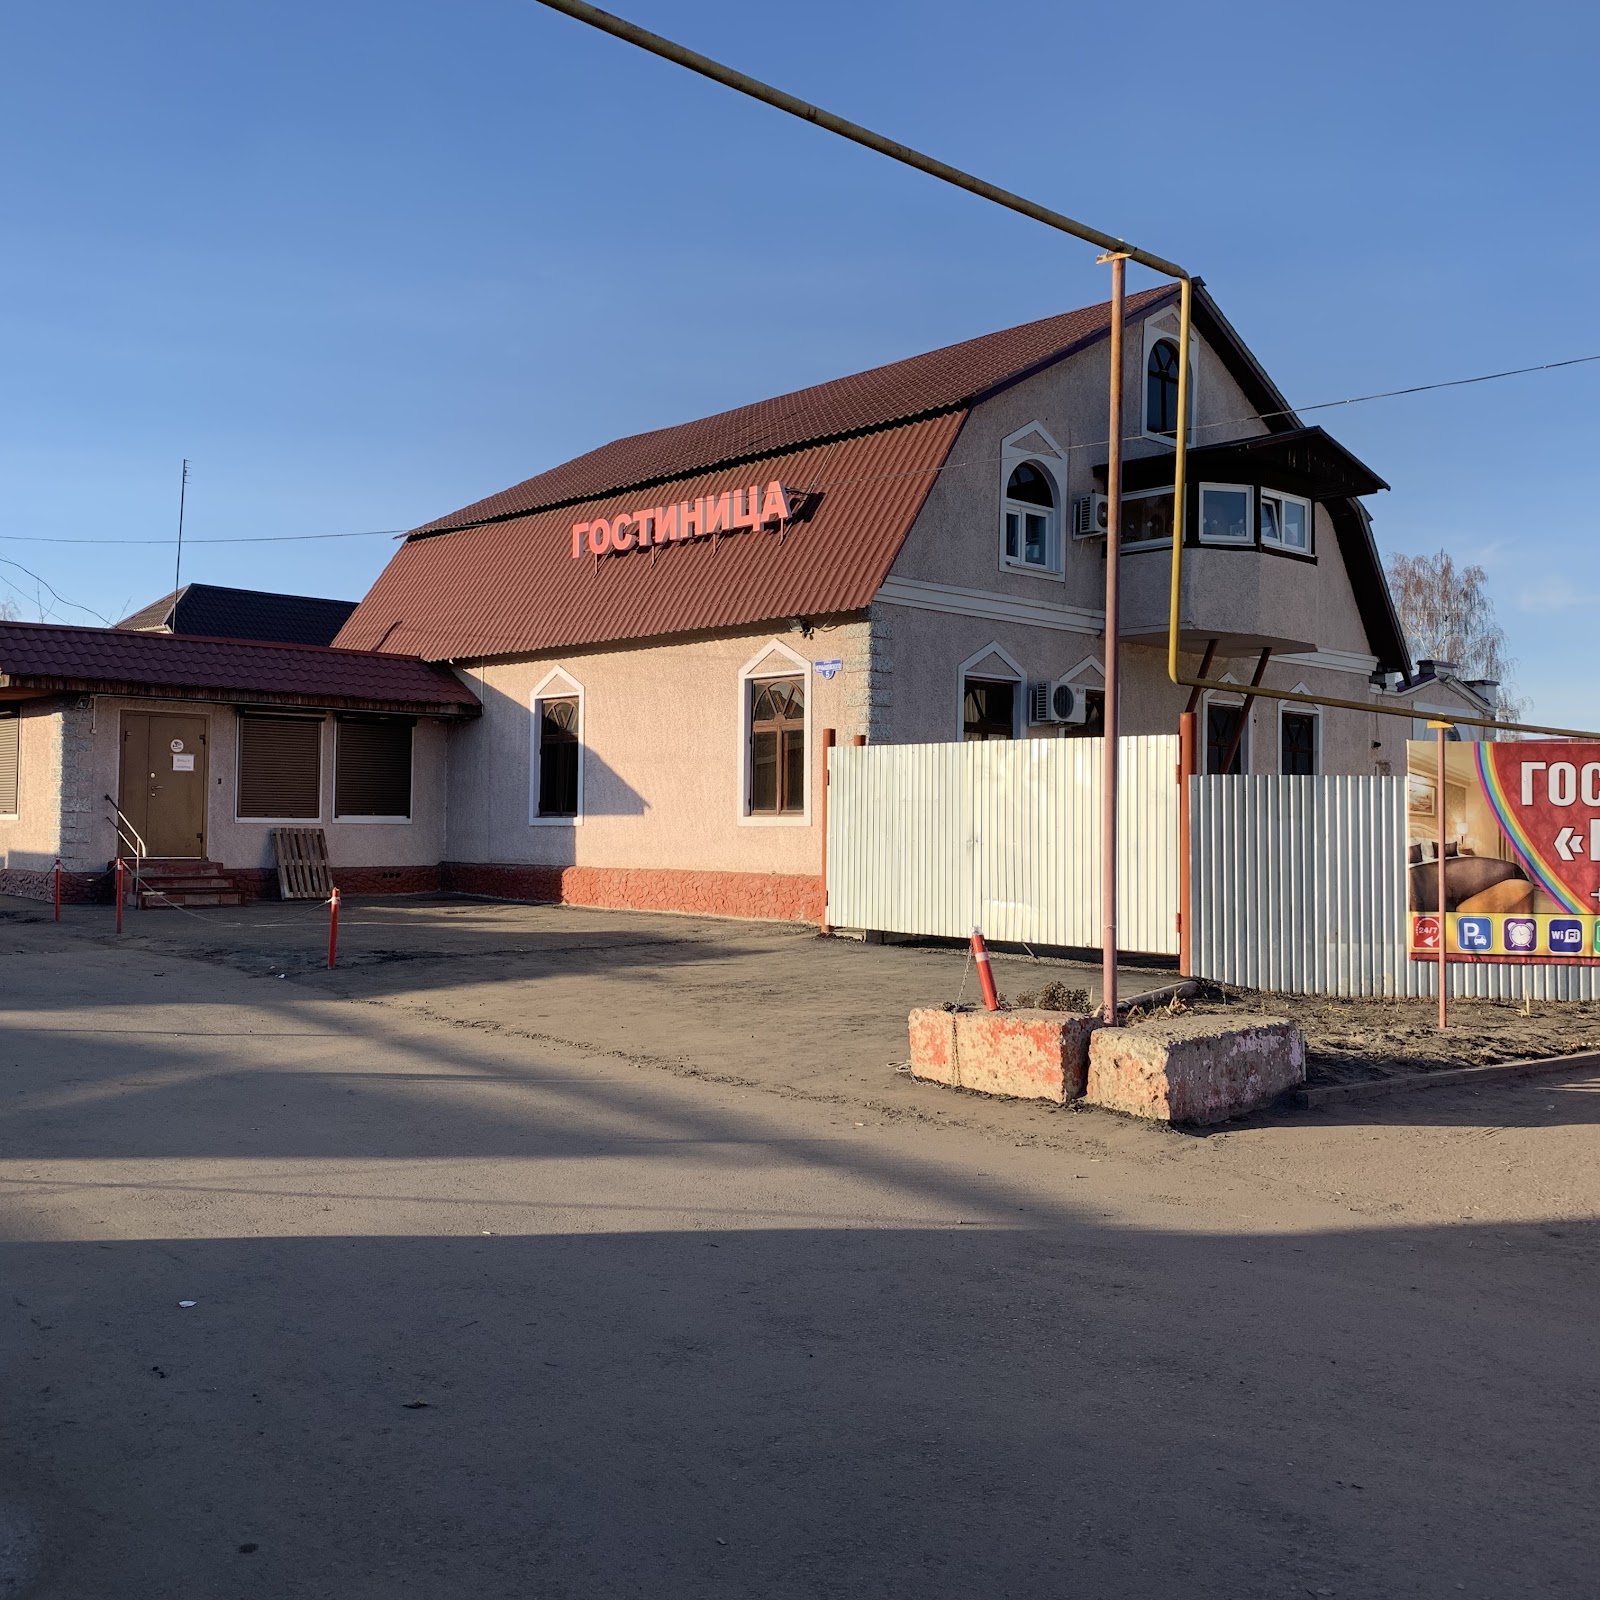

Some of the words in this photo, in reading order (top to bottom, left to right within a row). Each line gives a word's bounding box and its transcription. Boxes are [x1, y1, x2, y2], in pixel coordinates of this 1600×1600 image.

[572, 480, 791, 559] ГОСТИНИЦА
[825, 670, 830, 678] 5
[1520, 761, 1600, 807] ГОС
[1418, 926, 1438, 934] 24/7
[1463, 922, 1480, 946] P
